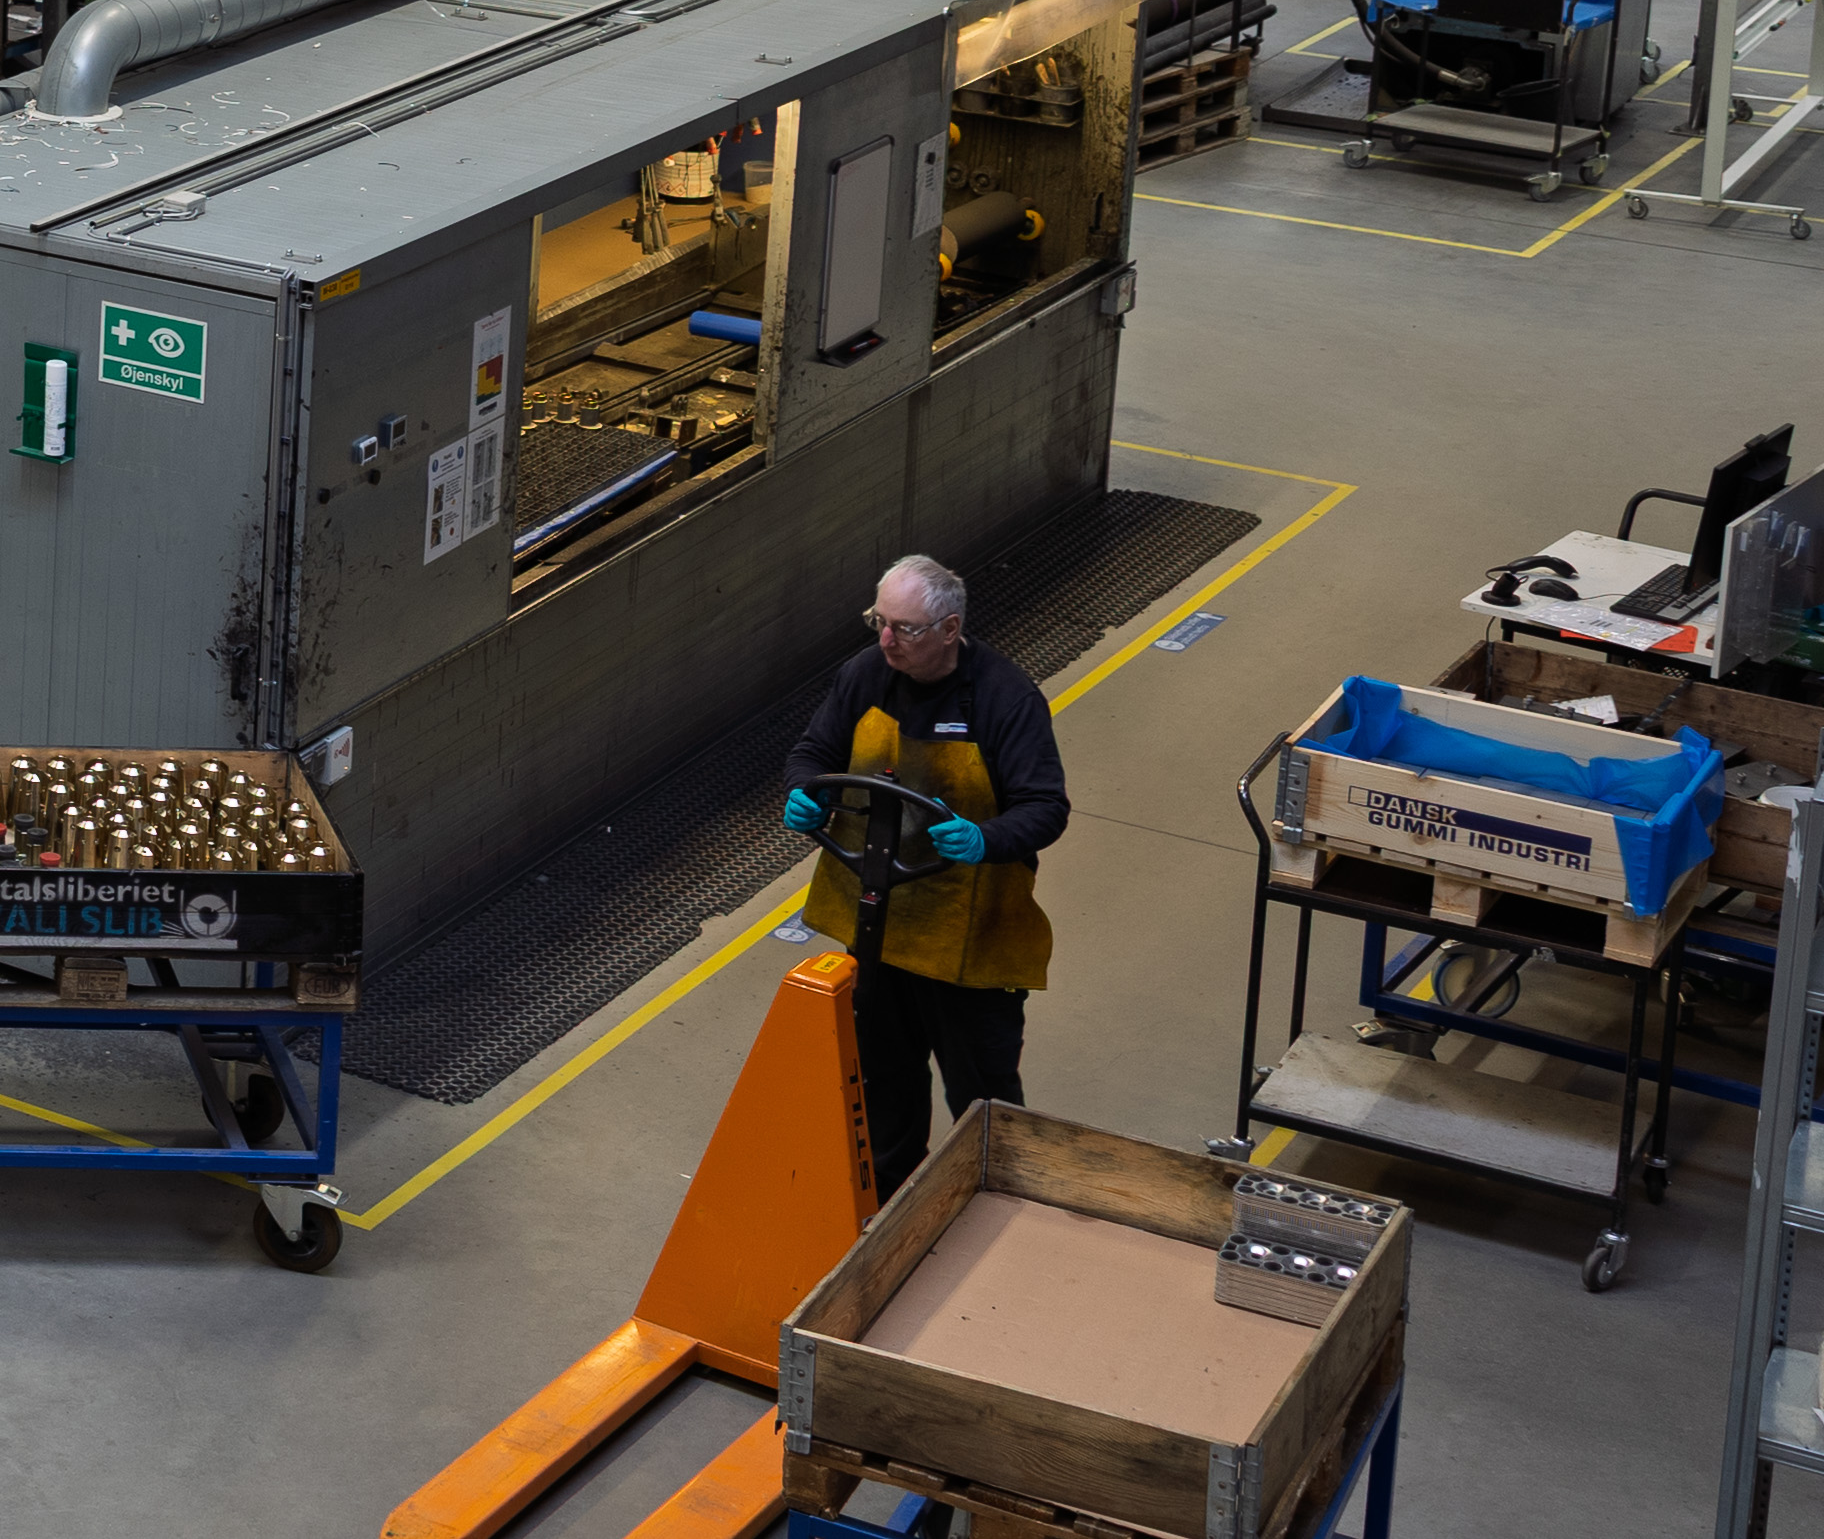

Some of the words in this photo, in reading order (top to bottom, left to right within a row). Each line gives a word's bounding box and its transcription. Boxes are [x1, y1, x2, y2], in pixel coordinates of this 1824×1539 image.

[120, 364, 184, 392] Øjenskyl
[1369, 791, 1458, 825] DANSK
[1367, 810, 1457, 844] GUMMI
[1468, 831, 1591, 873] INDUSTRI
[81, 906, 163, 936] SLIB
[848, 1057, 873, 1191] STILL
